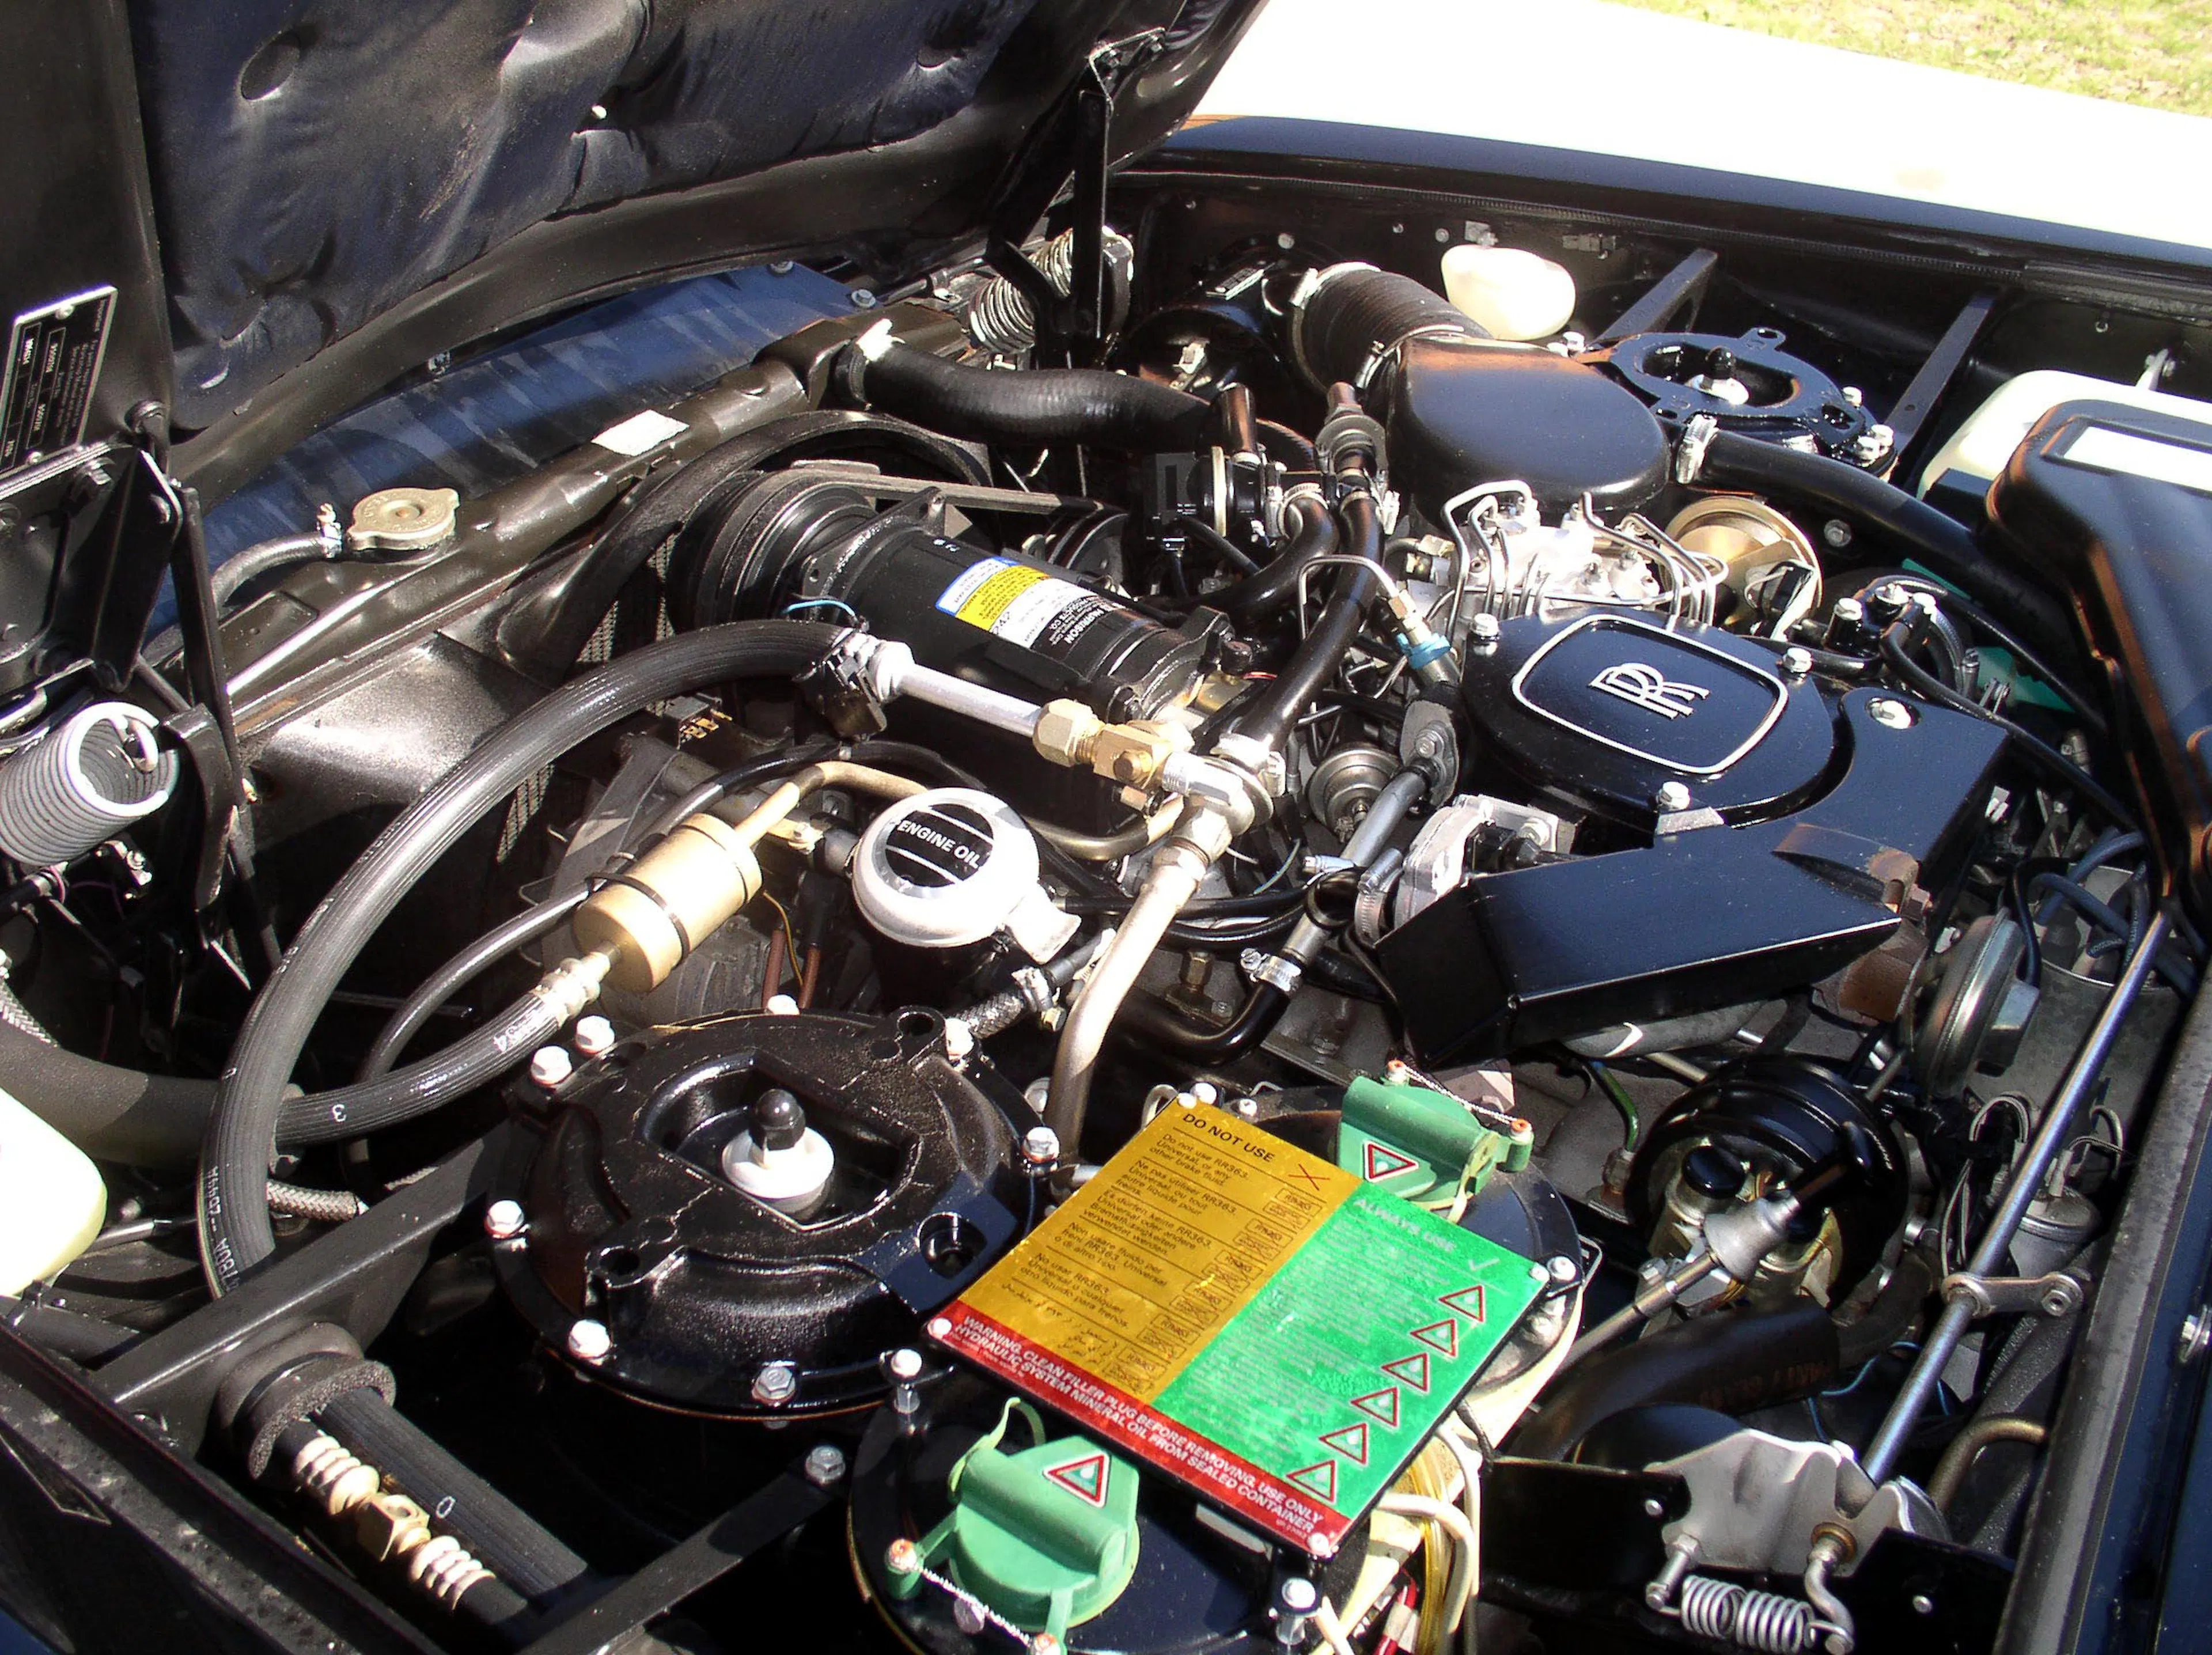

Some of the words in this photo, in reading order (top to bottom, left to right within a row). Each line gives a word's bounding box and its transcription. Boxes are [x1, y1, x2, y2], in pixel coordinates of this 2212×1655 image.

[897, 820, 956, 853] ENGINE
[953, 844, 980, 869] OIL
[1180, 1112, 1209, 1130] DO
[1206, 1125, 1244, 1146] NOT
[1241, 1142, 1277, 1162] USE
[1173, 1158, 1203, 1175] brake
[953, 1323, 1025, 1366] HYDRAULIC
[1019, 1361, 1073, 1394] SYSTEM
[1069, 1388, 1132, 1428] MINERAL
[1124, 1420, 1152, 1440] OIL
[1145, 1432, 1190, 1461] FROM
[1185, 1455, 1240, 1490] SEALED
[1234, 1483, 1316, 1534] CONTAINER
[1020, 1349, 1066, 1378] CLEAN
[1060, 1372, 1107, 1401] FILLER
[1101, 1394, 1140, 1420] PLUG
[1134, 1412, 1189, 1448] BEFORE
[1255, 1480, 1288, 1504] USE
[1282, 1496, 1325, 1525] ONLY
